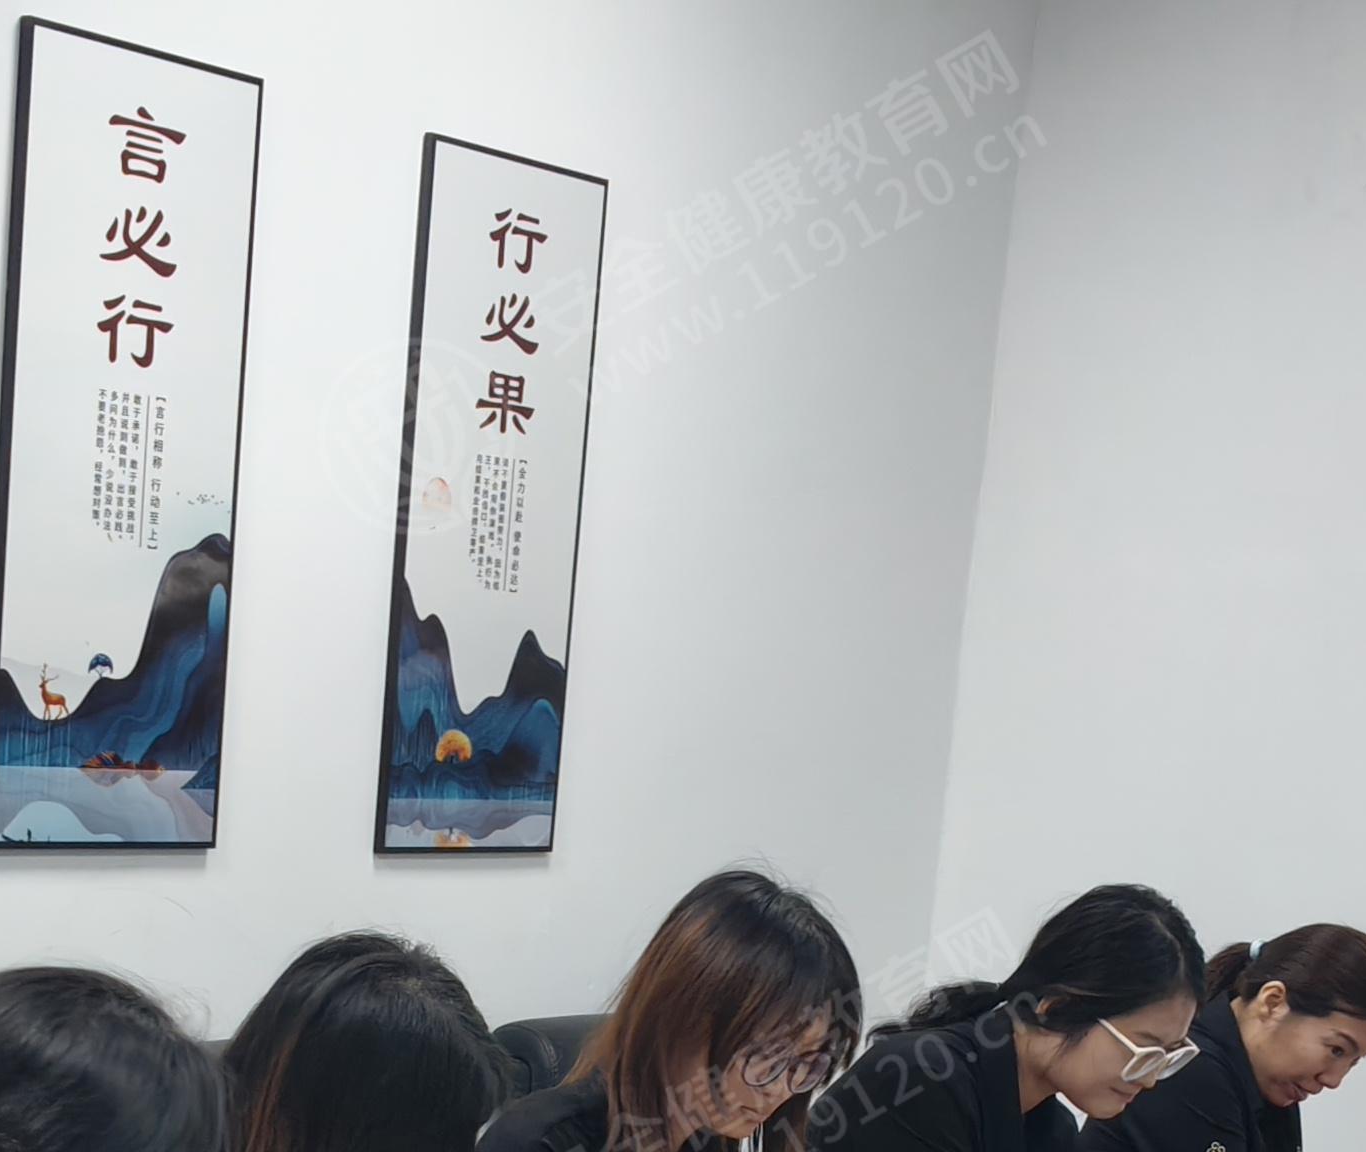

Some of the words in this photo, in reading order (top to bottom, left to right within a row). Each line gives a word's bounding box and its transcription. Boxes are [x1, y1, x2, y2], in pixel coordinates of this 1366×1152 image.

[96, 106, 187, 368] 言必行
[475, 208, 548, 435] 行必果
